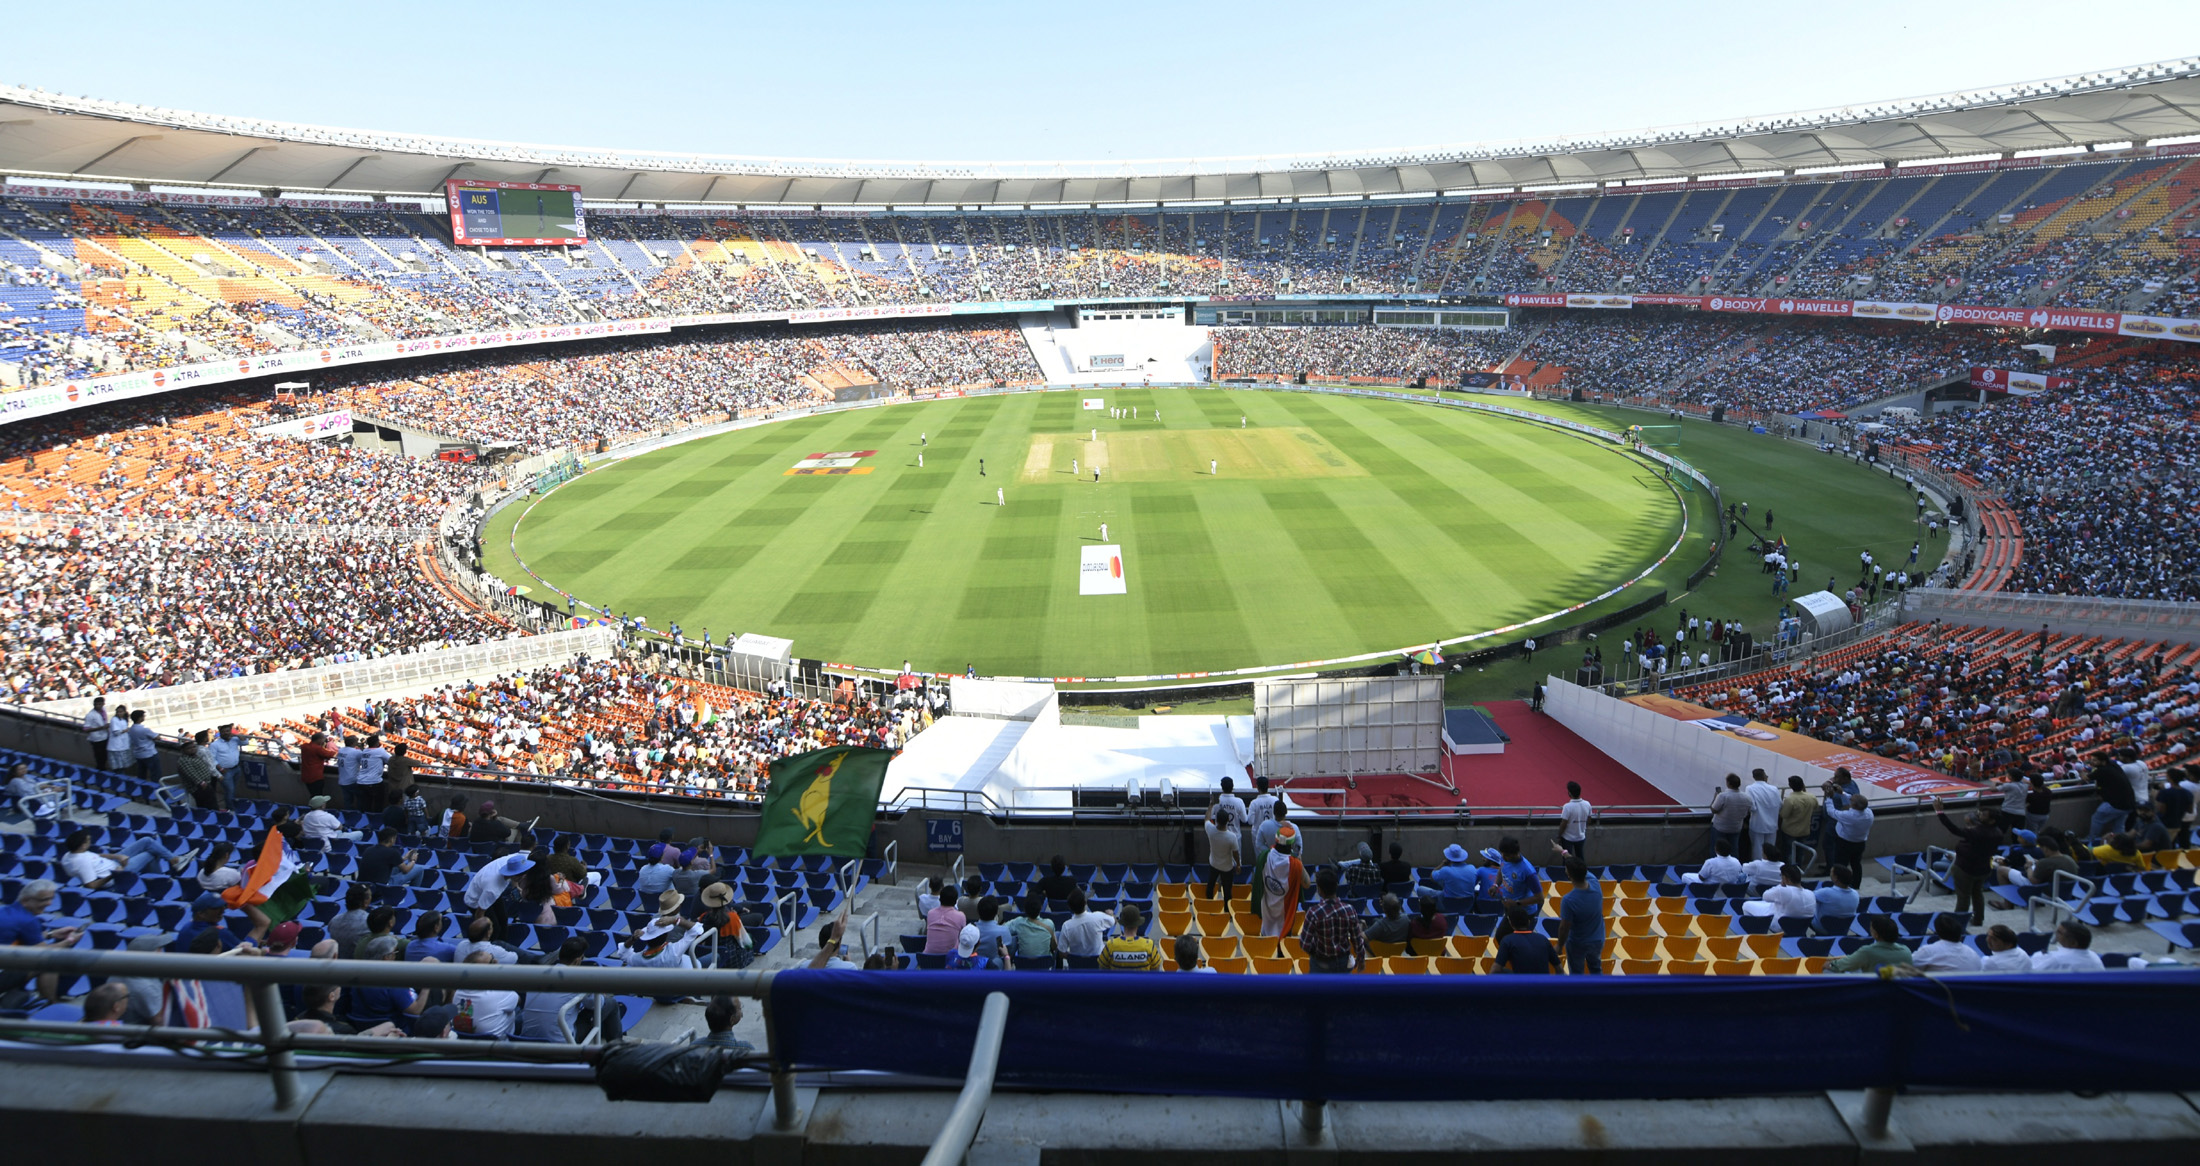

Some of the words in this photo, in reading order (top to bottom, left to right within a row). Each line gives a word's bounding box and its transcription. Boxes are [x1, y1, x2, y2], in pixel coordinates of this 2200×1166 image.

[472, 195, 487, 204] AUS
[1797, 303, 1848, 313] HAVELLS
[1954, 310, 2024, 322] BODYCARE
[2051, 315, 2114, 329] HAVELLS
[1972, 380, 2005, 389] BODYCARE
[258, 763, 264, 776] 7
[928, 820, 937, 835] 7
[952, 820, 961, 835] 6
